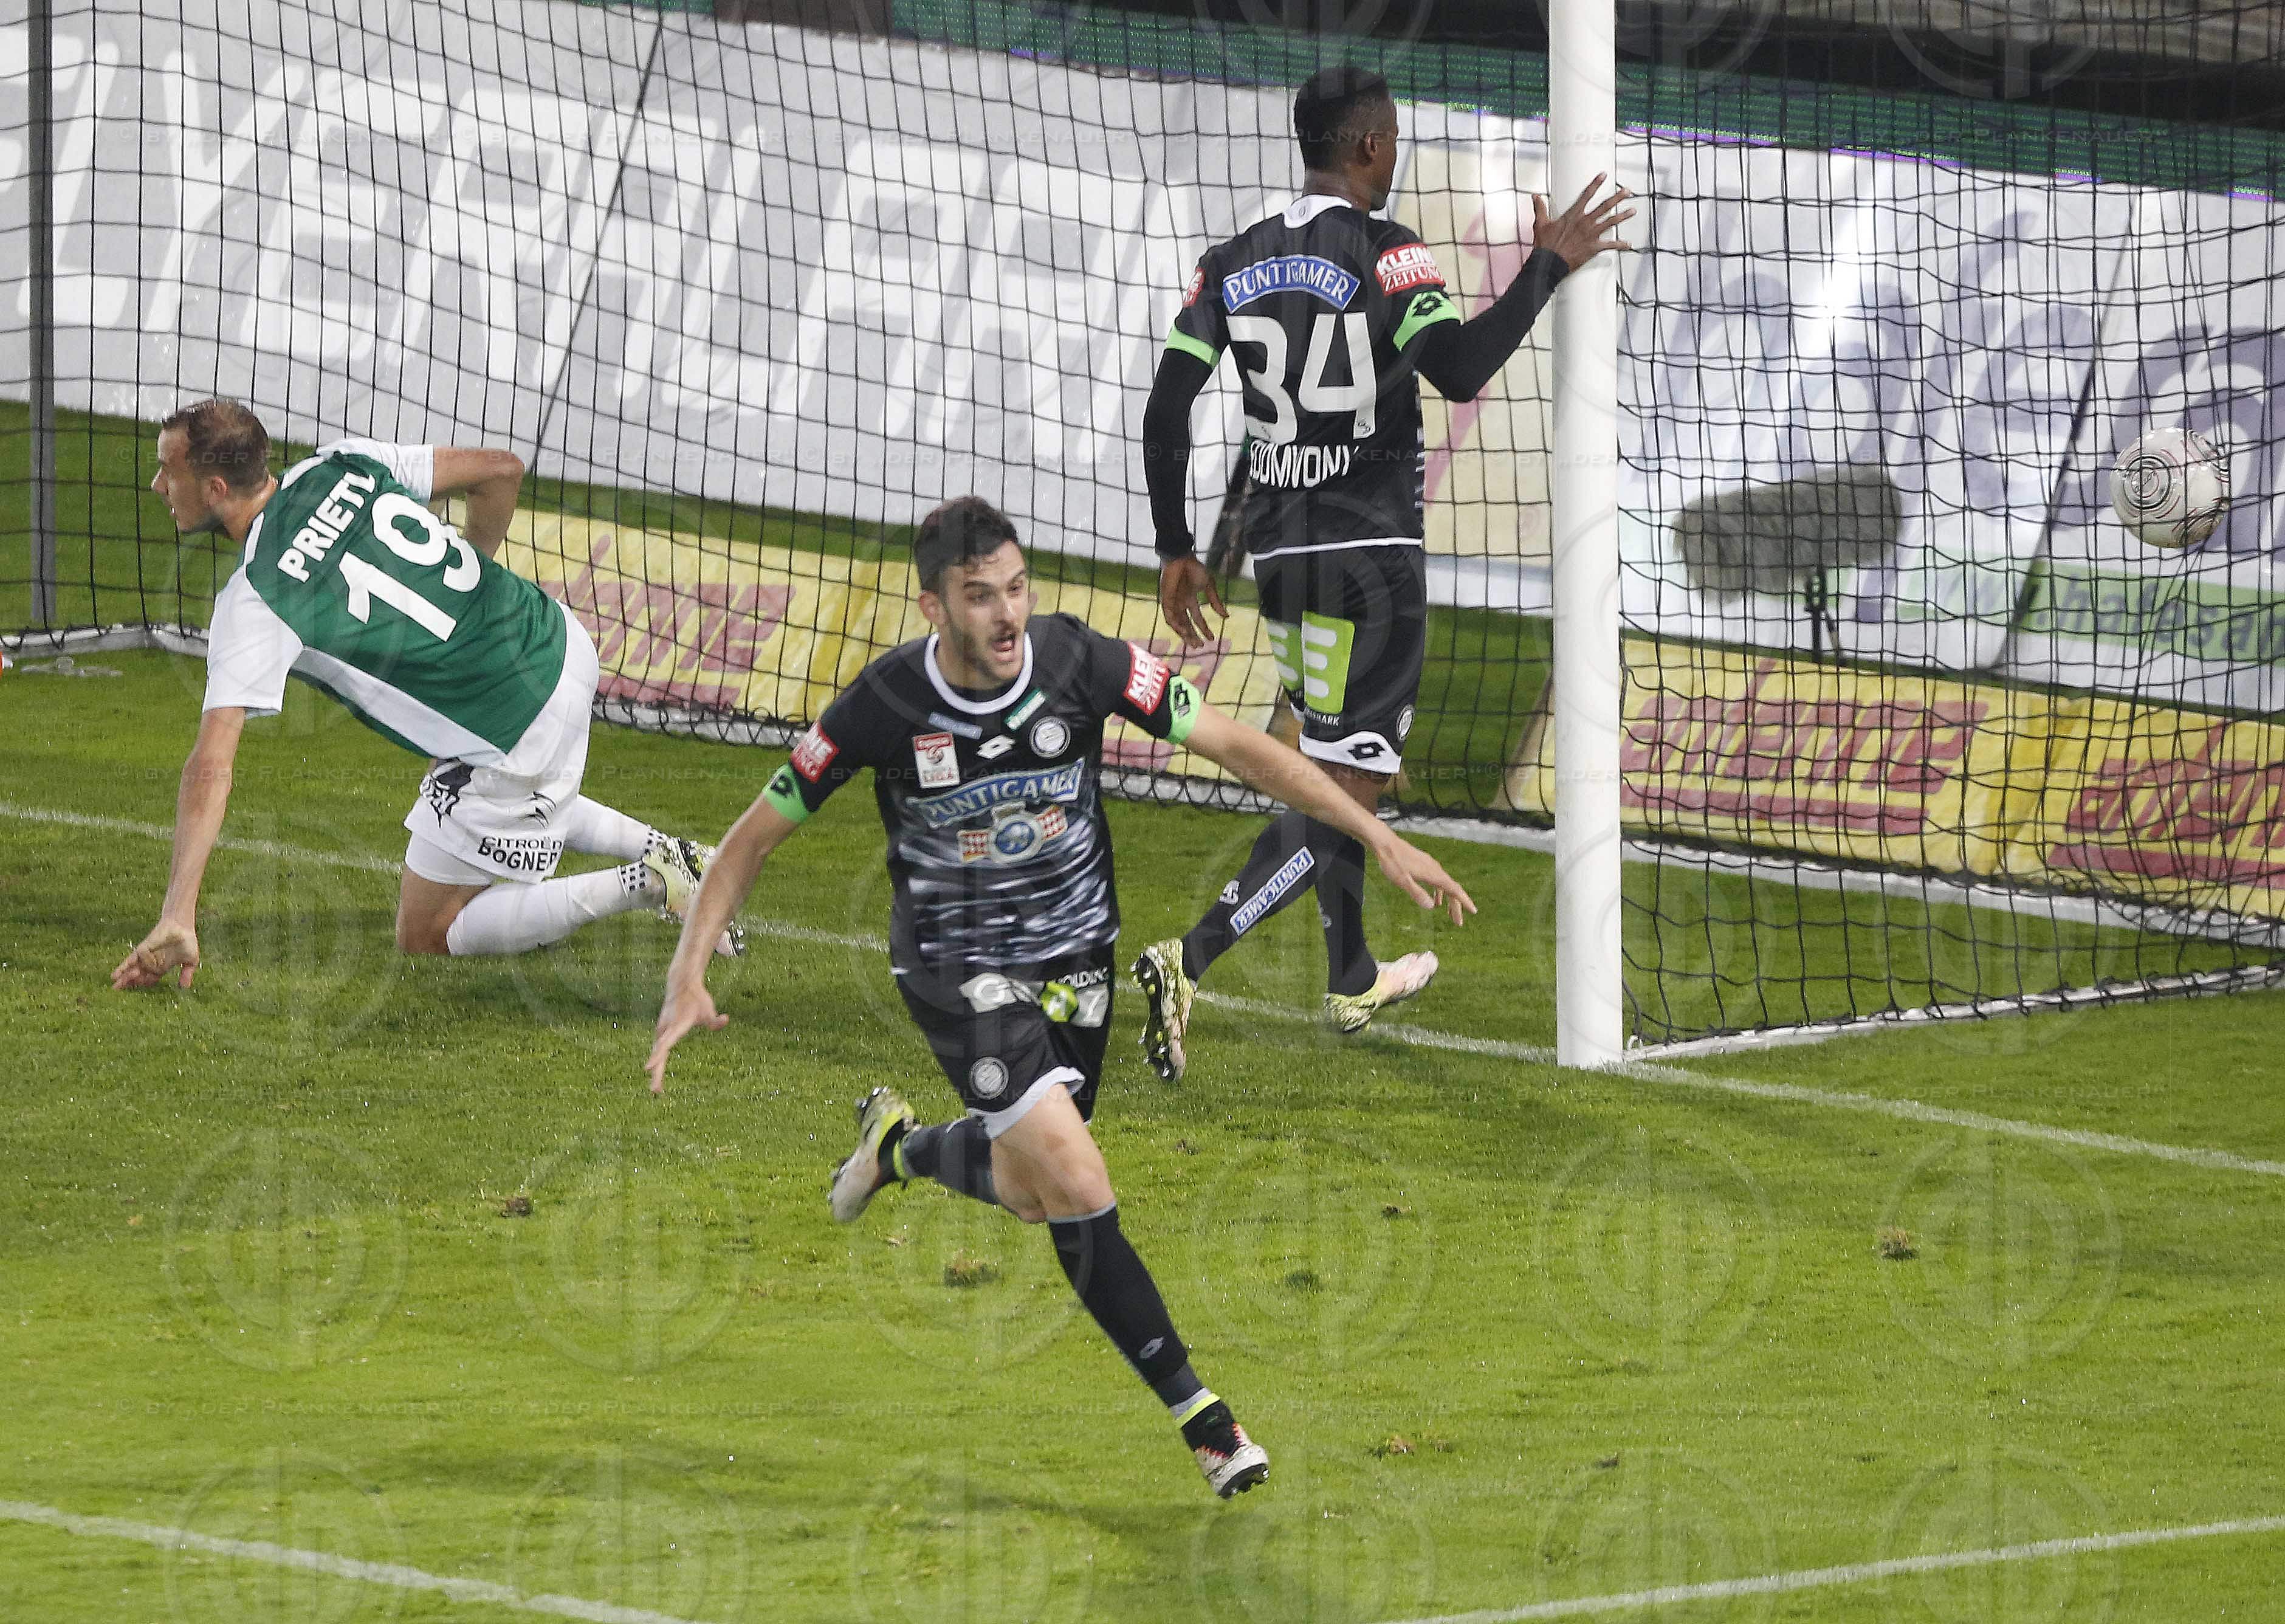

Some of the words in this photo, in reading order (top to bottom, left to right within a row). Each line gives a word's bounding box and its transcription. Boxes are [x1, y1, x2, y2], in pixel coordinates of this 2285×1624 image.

[1225, 261, 1352, 305] PUNTIGAMER
[1376, 246, 1434, 277] KLEIN
[1382, 266, 1443, 292] ZEITUN
[1226, 311, 1376, 446] 34
[277, 472, 376, 583] PRIETL
[338, 492, 481, 642] 19
[1237, 853, 1310, 927] PUNTIGAMER
